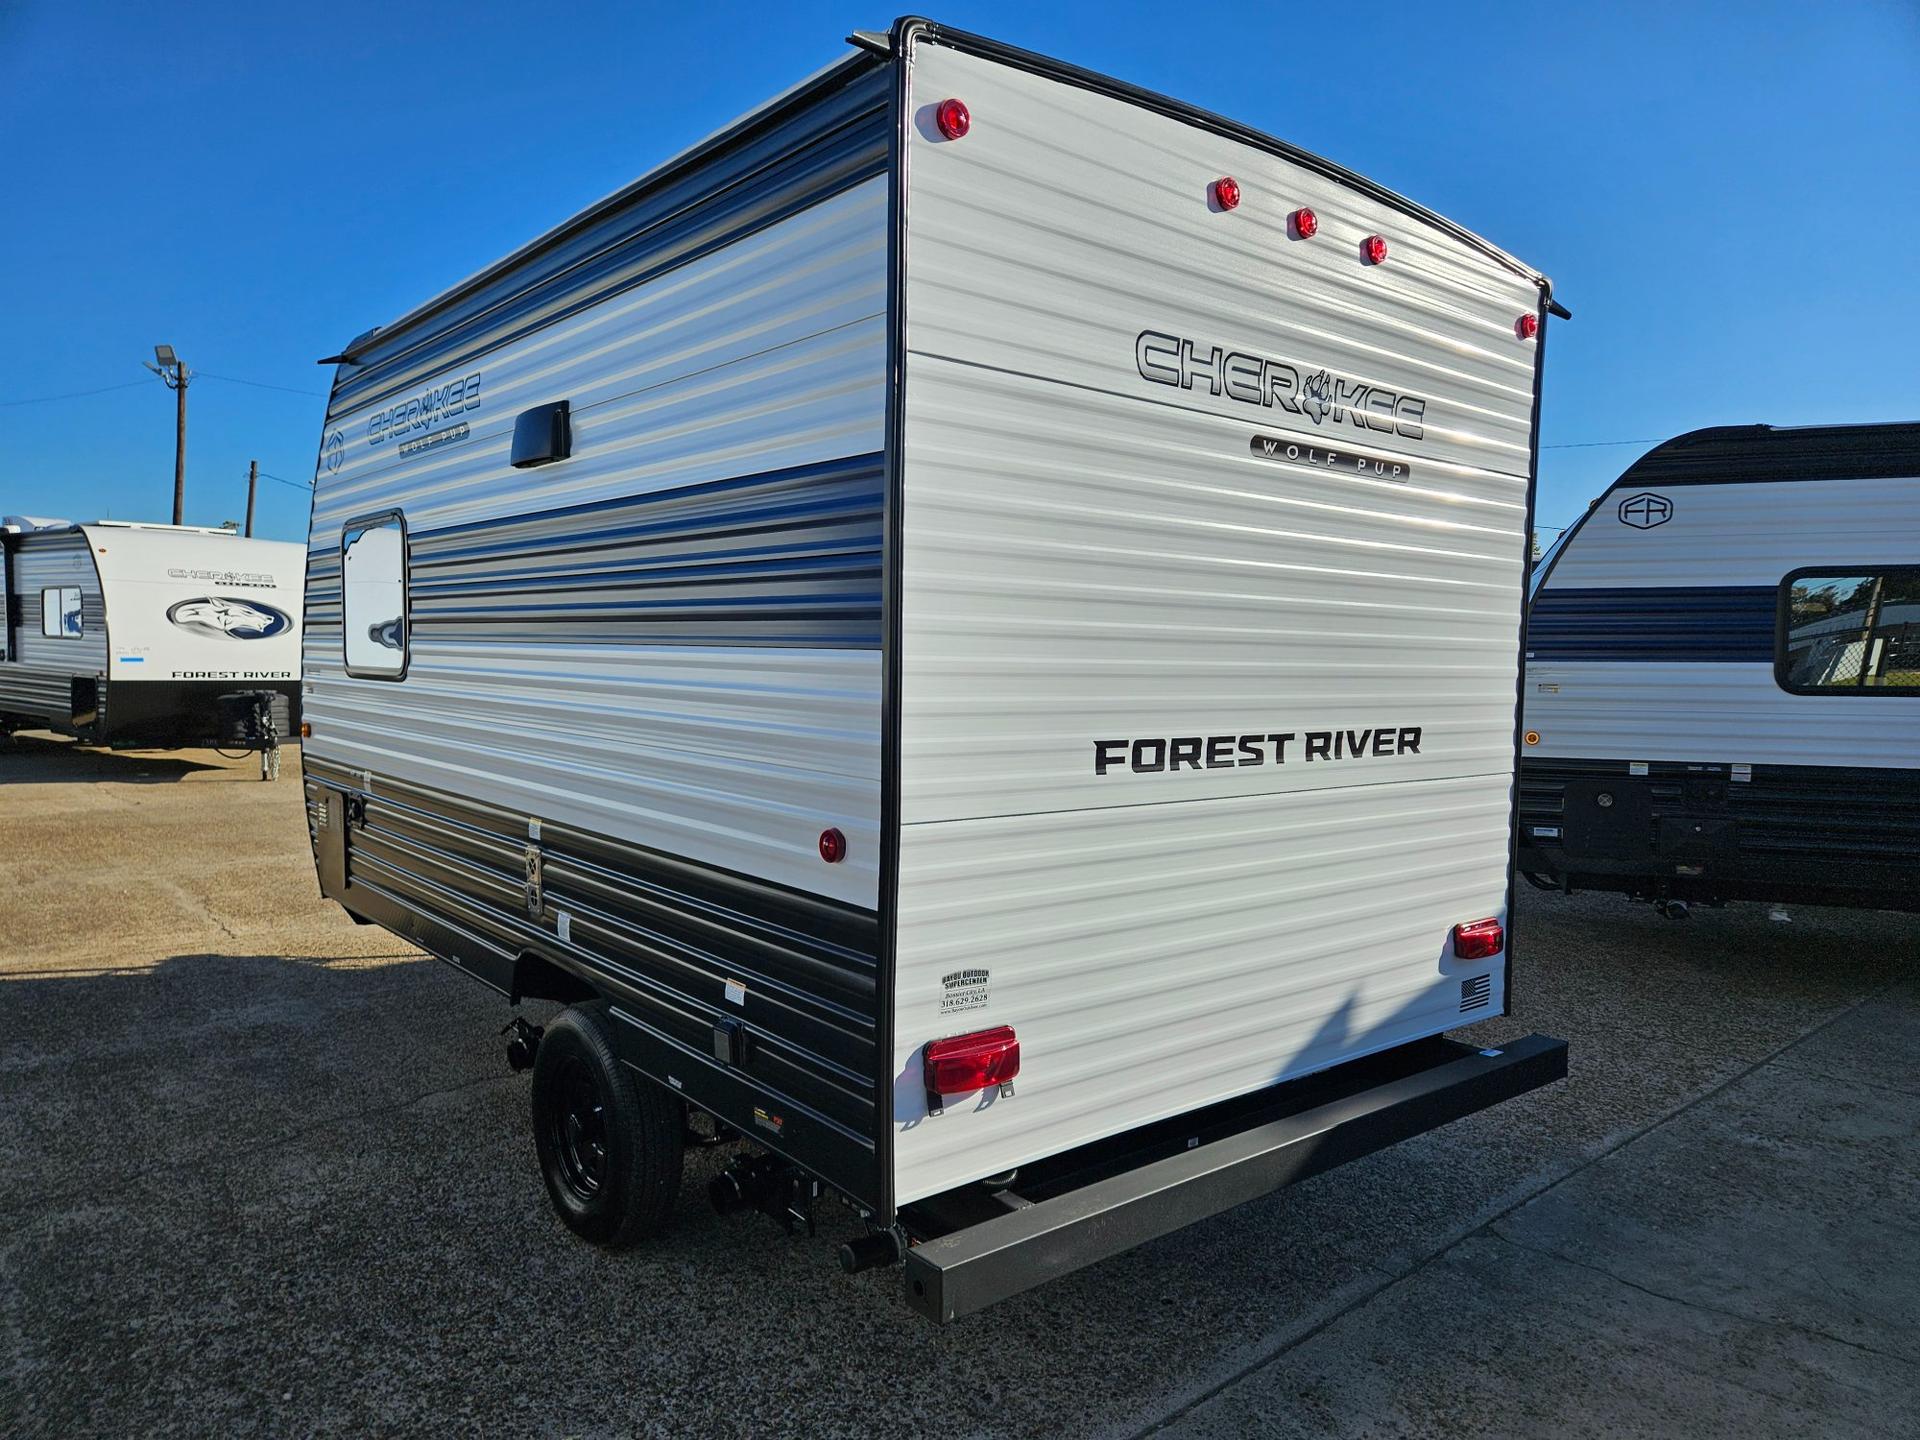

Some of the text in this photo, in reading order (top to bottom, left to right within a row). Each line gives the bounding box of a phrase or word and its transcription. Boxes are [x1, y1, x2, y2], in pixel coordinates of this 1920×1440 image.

[1135, 329, 1426, 441] CHEROKEE
[368, 372, 480, 445] CHEROKEE
[400, 425, 465, 454] WOLF PUP
[1262, 439, 1402, 479] WOLF PUP
[171, 671, 291, 679] FOREST RIVER
[1093, 726, 1422, 775] FOREST RIVER
[944, 977, 988, 990] SUPERCENTER
[962, 969, 989, 979] OUTDOOR
[941, 993, 988, 1009] 318.629.2628
